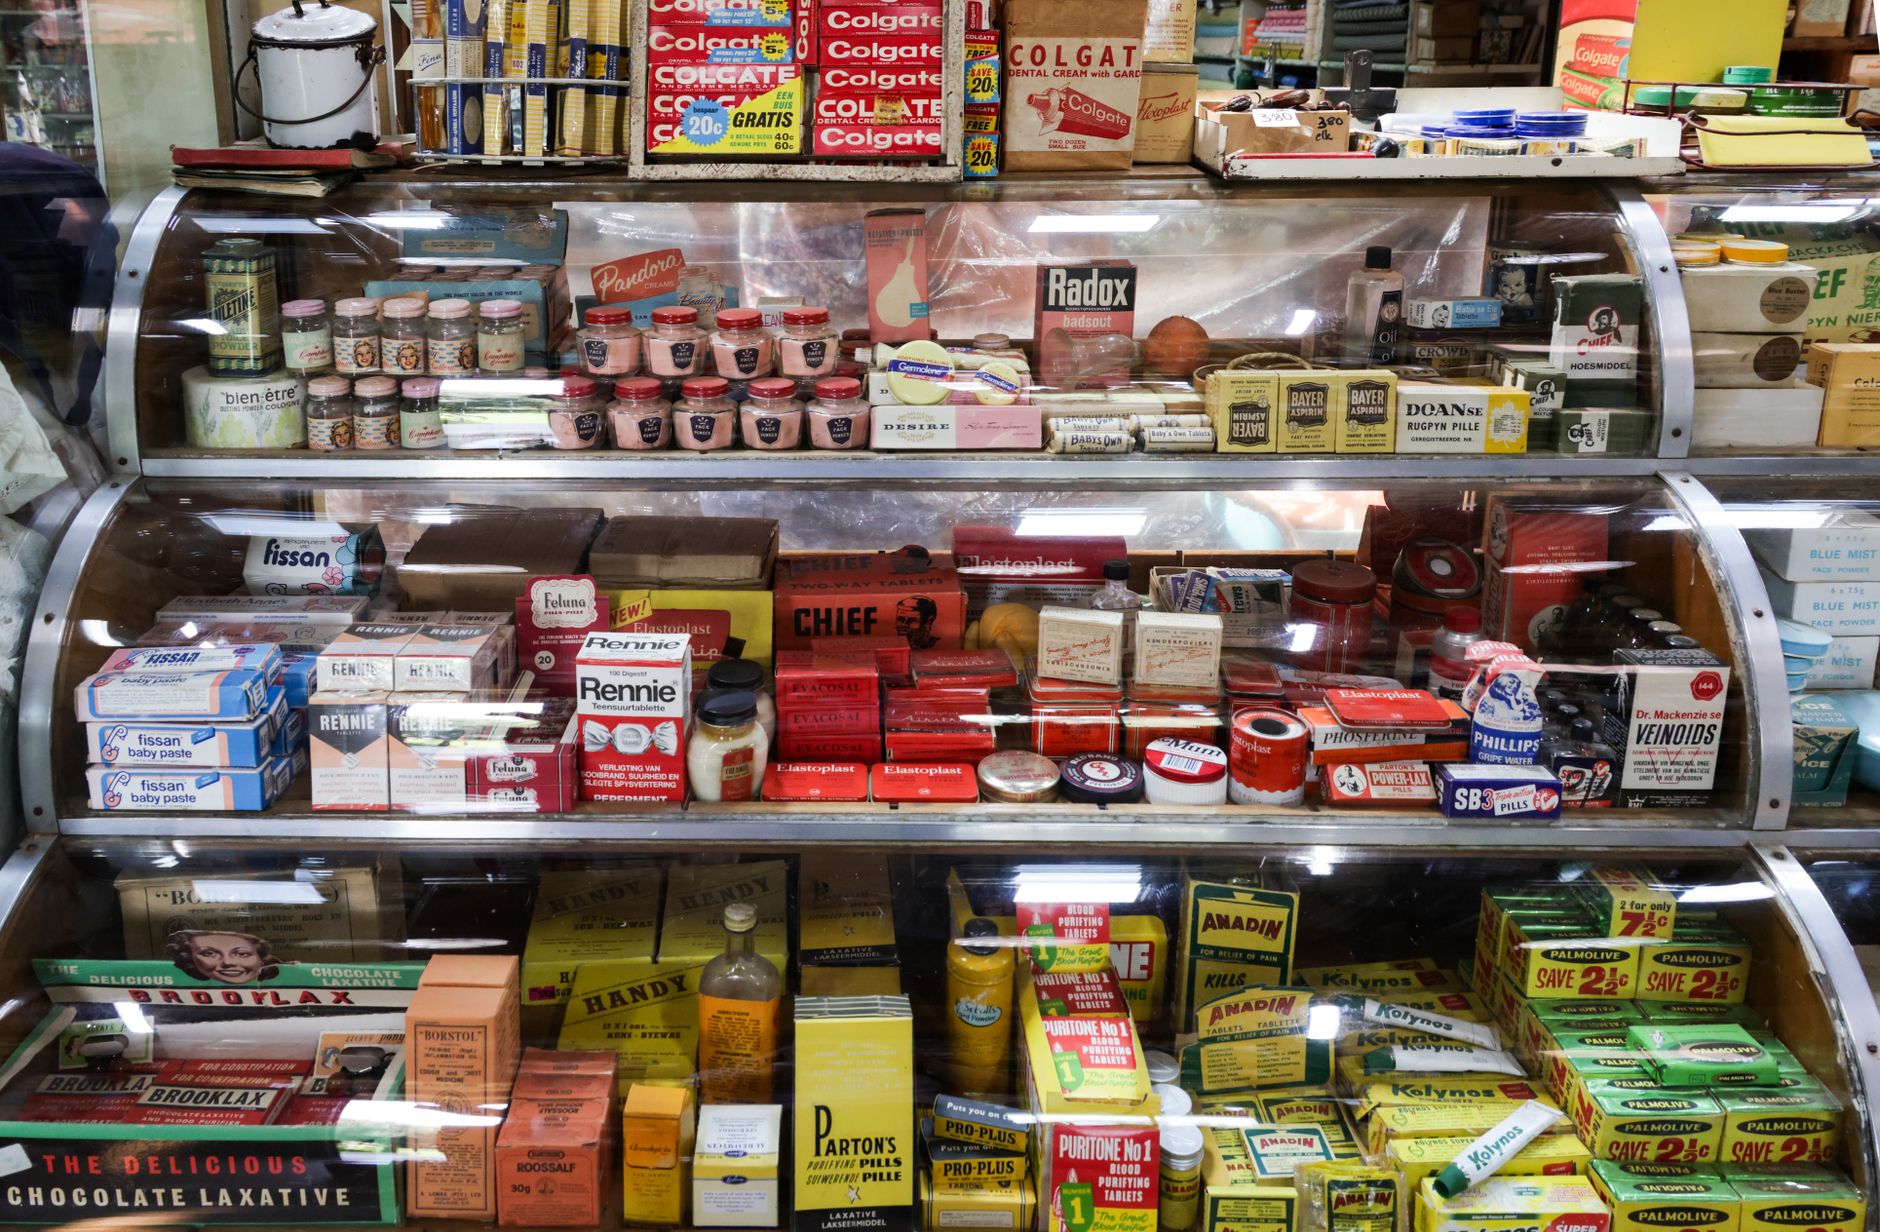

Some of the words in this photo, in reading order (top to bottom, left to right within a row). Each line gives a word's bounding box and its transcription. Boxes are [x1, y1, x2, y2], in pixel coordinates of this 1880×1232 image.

[1575, 47, 1619, 66] Colgate
[655, 66, 795, 84] COLGATE
[970, 68, 992, 77] SAVE
[1009, 69, 1049, 78] DENTAL
[1053, 69, 1088, 78] CREAM
[1091, 69, 1110, 78] with
[971, 78, 994, 93] 20c
[1560, 75, 1599, 98] Colgate
[776, 92, 793, 100] EEN
[732, 112, 793, 128] GRATIS
[1260, 110, 1293, 123] 380
[1317, 116, 1343, 128] 380
[689, 116, 722, 135] 20c
[966, 121, 990, 130] FREE
[821, 128, 941, 149] Colgate
[774, 142, 794, 150] 60c
[971, 142, 992, 150] SAVE
[971, 151, 994, 166] 20c
[594, 254, 682, 301] Pandora
[645, 281, 675, 289] CREAMS
[1048, 269, 1129, 307] Radox
[1063, 315, 1111, 328] badsout
[1379, 331, 1397, 343] Oil
[1418, 348, 1468, 356] CROWD
[899, 362, 942, 376] Germolene
[1570, 362, 1632, 370] HOESMIDDEL
[1291, 392, 1323, 406] BAYER
[1351, 390, 1384, 405] BAYER
[1290, 408, 1323, 416] ASPIRIN
[1408, 422, 1447, 431] RUGPYN
[1452, 422, 1480, 431] PILLE
[264, 538, 330, 567] fissan
[1809, 550, 1841, 559] BLUE
[1847, 549, 1877, 559] MIST
[544, 592, 586, 609] Feluna
[1813, 602, 1844, 611] BLUE
[1853, 601, 1878, 610] MIST
[609, 600, 646, 626] NEW!
[794, 606, 878, 637] CHIEF
[355, 626, 408, 634] RENNIE
[430, 627, 482, 635] RENNIE
[586, 637, 681, 650] Rennie
[538, 656, 551, 664] 20
[1831, 657, 1862, 667] MIST
[581, 676, 676, 702] Rennie
[1698, 682, 1713, 690] 144
[1340, 689, 1423, 700] Elastoplast
[592, 703, 665, 712] Teensuurtablette
[1636, 710, 1651, 719] Dr.
[1654, 710, 1706, 719] Mackenzie
[320, 714, 375, 731] RENNIE
[138, 733, 181, 747] fissan
[1636, 724, 1717, 744] VEINOIDS
[128, 747, 152, 759] baby
[155, 748, 192, 760] paste
[1166, 739, 1222, 757] Mum
[1478, 752, 1502, 763] GRIPE
[1505, 756, 1532, 764] WATER
[493, 762, 527, 773] Feluna
[776, 764, 856, 773] Elastoplast
[884, 766, 962, 775] Elastoplast
[614, 780, 676, 788] SPYSVERTERING
[1372, 772, 1430, 785] POWER-LAX
[141, 779, 185, 792] fissan
[131, 793, 155, 804] baby
[158, 794, 196, 805] paste
[1454, 788, 1494, 811] SB3
[1501, 800, 1528, 811] PILLS
[1620, 901, 1627, 909] 2
[1630, 901, 1646, 910] for
[1650, 901, 1672, 912] only
[1058, 916, 1103, 927] PURIFYING
[1202, 912, 1284, 941] ANADIN
[1064, 928, 1098, 938] TABLETS
[1219, 950, 1244, 959] RELIEF
[1260, 954, 1278, 962] PAIN
[1551, 951, 1621, 959] PALMOLIVE
[1662, 954, 1733, 965] PALMOLIVE
[48, 964, 79, 975] THE
[311, 968, 402, 979] CHOCOLATE
[90, 975, 173, 985] DELICIOUS
[322, 978, 396, 987] LAXATIVE
[1204, 972, 1246, 988] KILLS
[1323, 973, 1412, 988] Kolynos
[1075, 984, 1103, 992] BLOOD
[583, 975, 688, 1015] HANDY
[1067, 992, 1114, 1000] PURIFYING
[1076, 1000, 1110, 1009] TABLETS
[1209, 995, 1296, 1027] ANADIN
[1376, 1003, 1453, 1031] Kolynos
[1044, 1021, 1099, 1036] PURITONE
[1103, 1022, 1119, 1036] No
[1120, 1023, 1128, 1036] 1
[1091, 1037, 1120, 1045] BLOOD
[1082, 1046, 1132, 1055] PURIFYING
[1090, 1056, 1127, 1064] TABLETS
[198, 1062, 220, 1071] FOR
[220, 1063, 297, 1072] CONSTIPATION
[1392, 1083, 1495, 1098] Kolynos
[148, 1089, 266, 1107] BROOKLAX
[947, 1103, 966, 1111] Puts
[969, 1105, 986, 1116] you
[988, 1110, 1000, 1118] on
[1628, 1100, 1698, 1109] PALMOLIVE
[1276, 1105, 1329, 1119] ANADIN
[814, 1105, 896, 1157] PARTON'S
[945, 1120, 1016, 1144] PRO-PLUS
[1624, 1123, 1701, 1132] PALMOLIVE
[1747, 1122, 1825, 1131] PALMOLIVE
[1060, 1135, 1121, 1161] PURITONE
[1124, 1140, 1142, 1159] No
[1144, 1141, 1151, 1161] 1
[1260, 1138, 1314, 1149] ANADIN
[1468, 1124, 1524, 1170] Kolynos
[43, 1155, 102, 1174] THE
[125, 1155, 307, 1175] DELICIOUS
[517, 1163, 576, 1173] ROOSSALF
[806, 1159, 856, 1172] PURIFYING
[859, 1158, 902, 1168] PILLS
[944, 1161, 1014, 1176] PRO-PLUS
[1109, 1164, 1140, 1175] BLOOD
[862, 1172, 902, 1182] PILLE
[1099, 1176, 1150, 1188] PURIFYING
[511, 1184, 530, 1194] 30g
[7, 1186, 186, 1207] CHOCOLATE
[200, 1188, 350, 1206] LAXATIVE
[1105, 1190, 1143, 1202] TABLETS
[830, 1211, 877, 1220] LAXATIVE
[1638, 1211, 1726, 1221] PALMOLIVE
[1764, 1210, 1845, 1220] PALMOLIVE
[821, 1219, 887, 1229] LAKSEERMIDDEL
